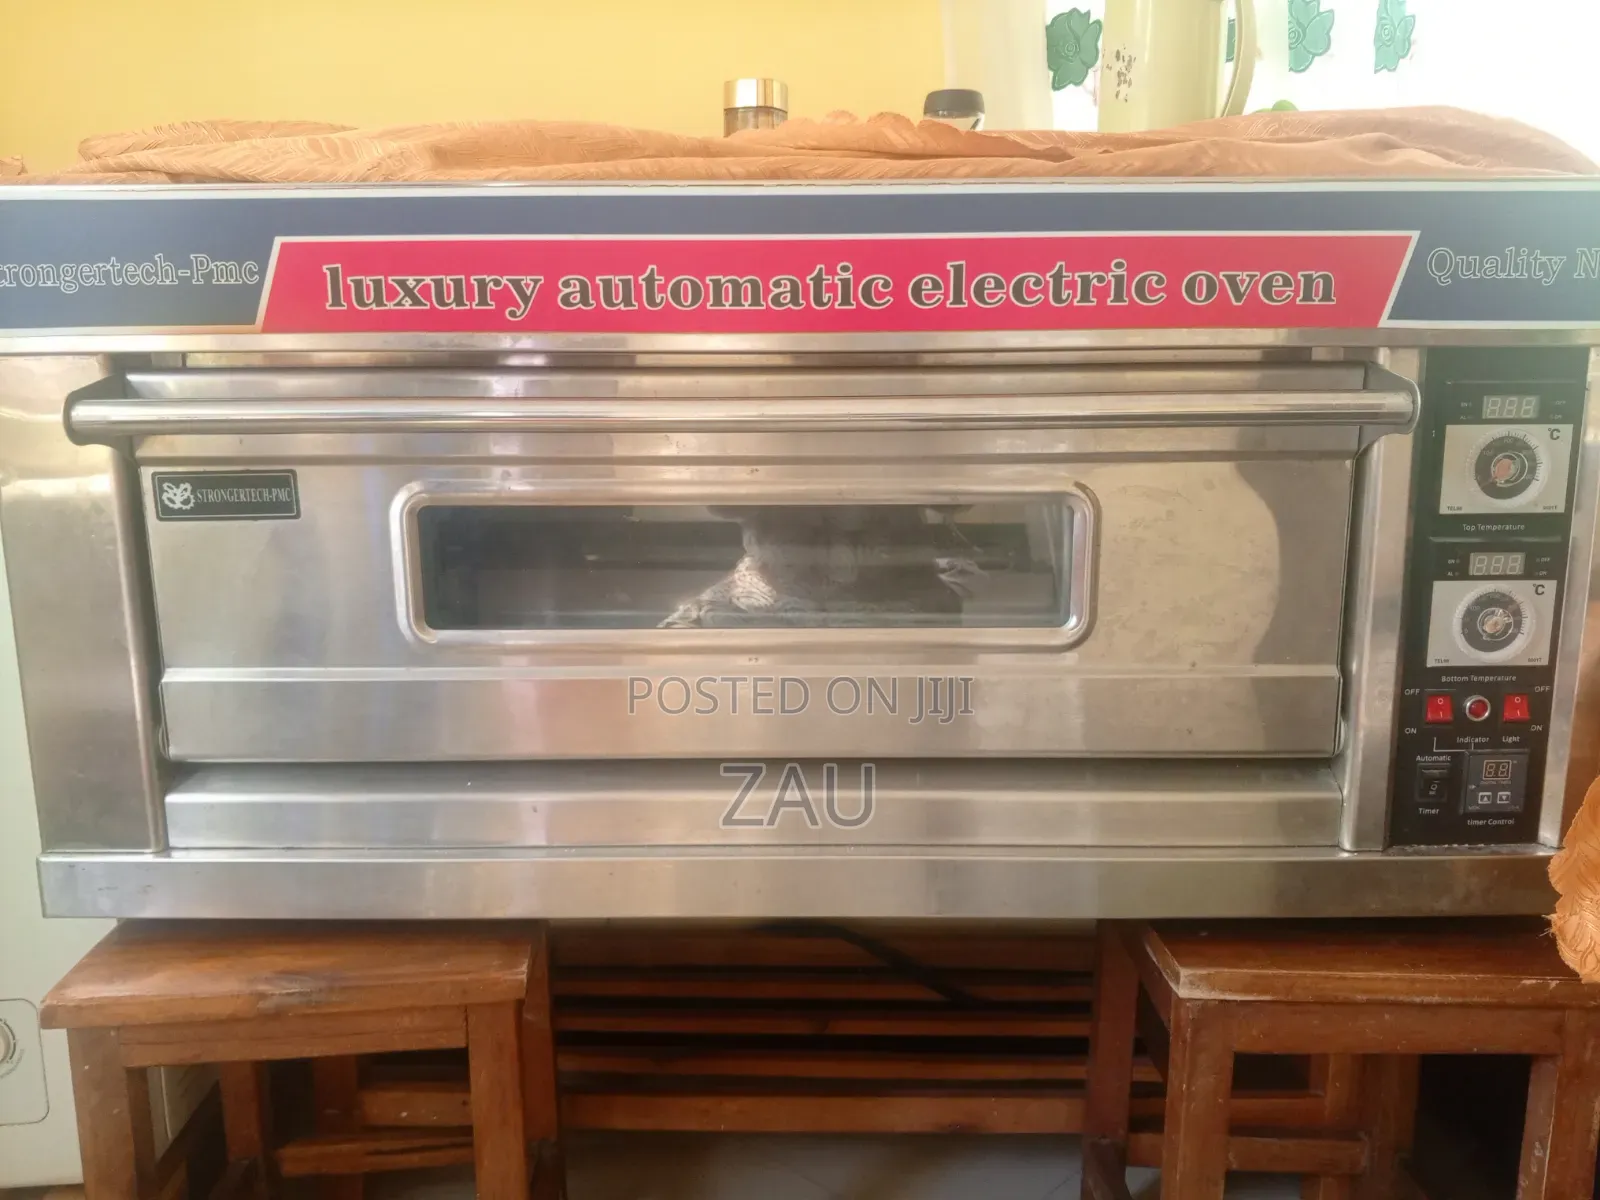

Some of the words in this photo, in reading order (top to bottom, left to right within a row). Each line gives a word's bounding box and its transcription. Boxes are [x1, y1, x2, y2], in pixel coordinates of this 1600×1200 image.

[1427, 247, 1567, 286] Quality
[321, 264, 544, 321] luxury
[557, 262, 894, 310] automatic
[908, 259, 1168, 308] electric
[1181, 269, 1337, 305] oven
[196, 487, 291, 503] STRONGERTECH-PMC
[1463, 523, 1476, 532] Top
[1477, 523, 1526, 532] Temperature
[1470, 674, 1517, 682] Temperature
[1404, 688, 1420, 696] OFF
[1534, 685, 1551, 693] OFF
[1404, 727, 1418, 735] ON
[1530, 724, 1543, 732] ON
[1456, 735, 1490, 744] Indicator
[1502, 735, 1521, 744] Light
[1416, 754, 1452, 762] Automatic
[1418, 807, 1440, 815] Timer
[1467, 818, 1487, 826] timer
[1487, 817, 1515, 826] Control
